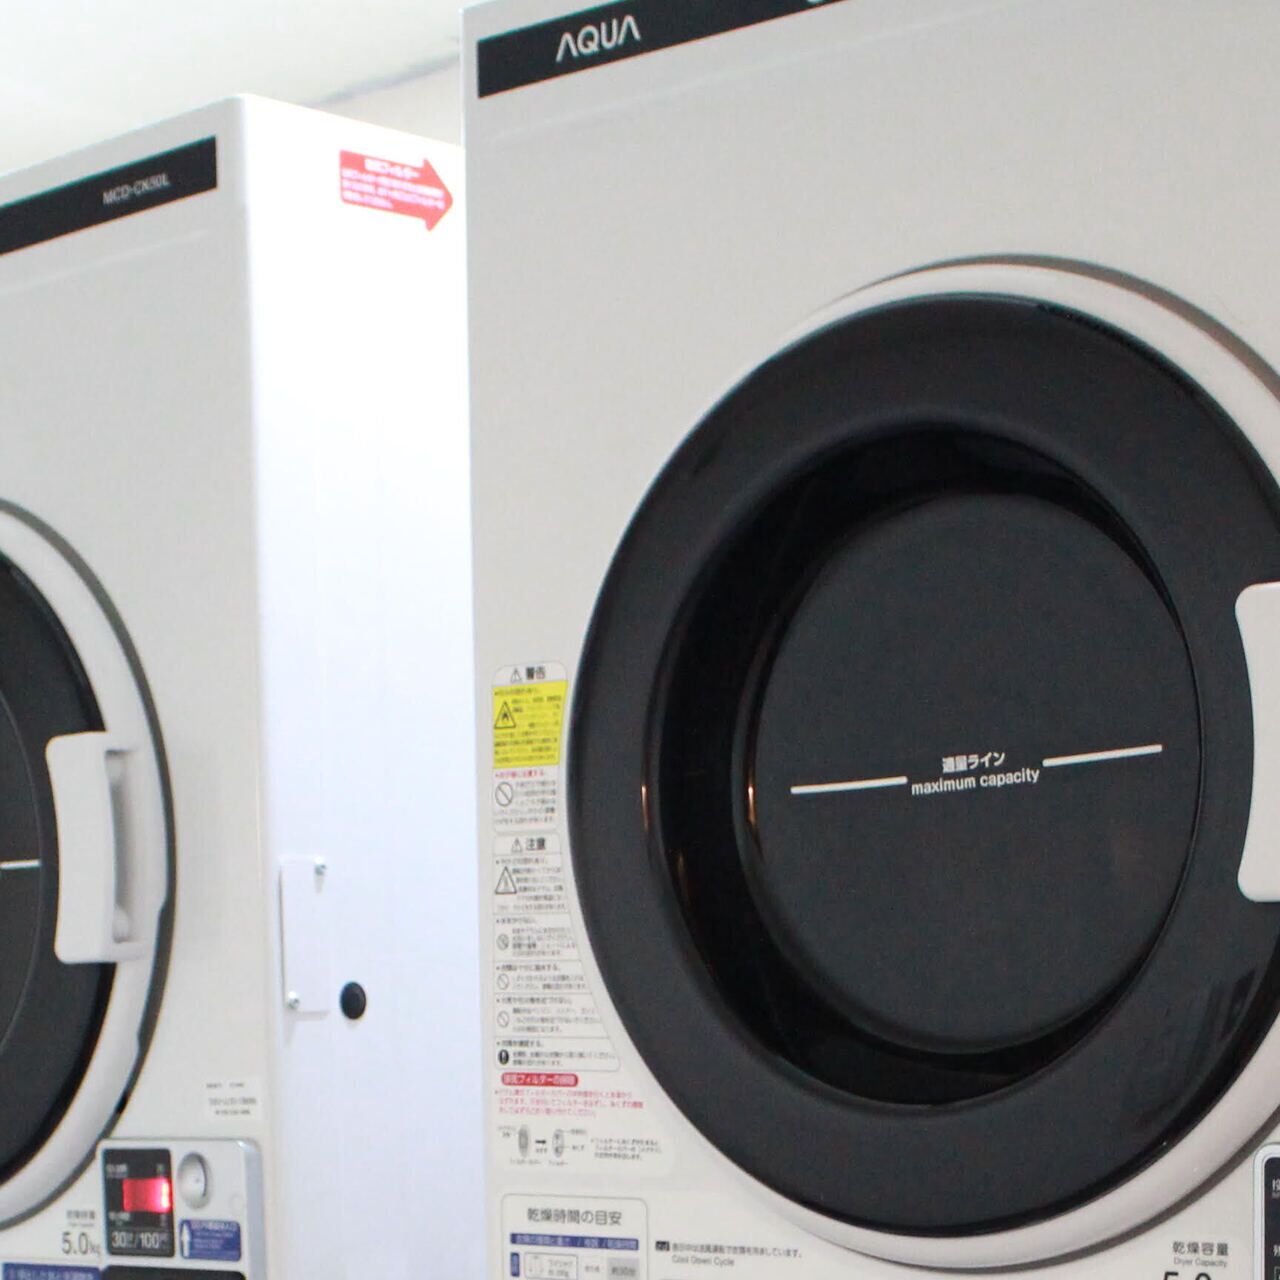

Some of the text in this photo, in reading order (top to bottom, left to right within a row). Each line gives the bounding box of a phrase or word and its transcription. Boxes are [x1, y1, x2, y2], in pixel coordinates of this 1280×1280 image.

[556, 14, 642, 63] AQUA
[911, 767, 1040, 796] maximum capacity
[527, 1207, 623, 1225] 乾燥時間の目安
[1172, 1241, 1229, 1256] 乾燥容量
